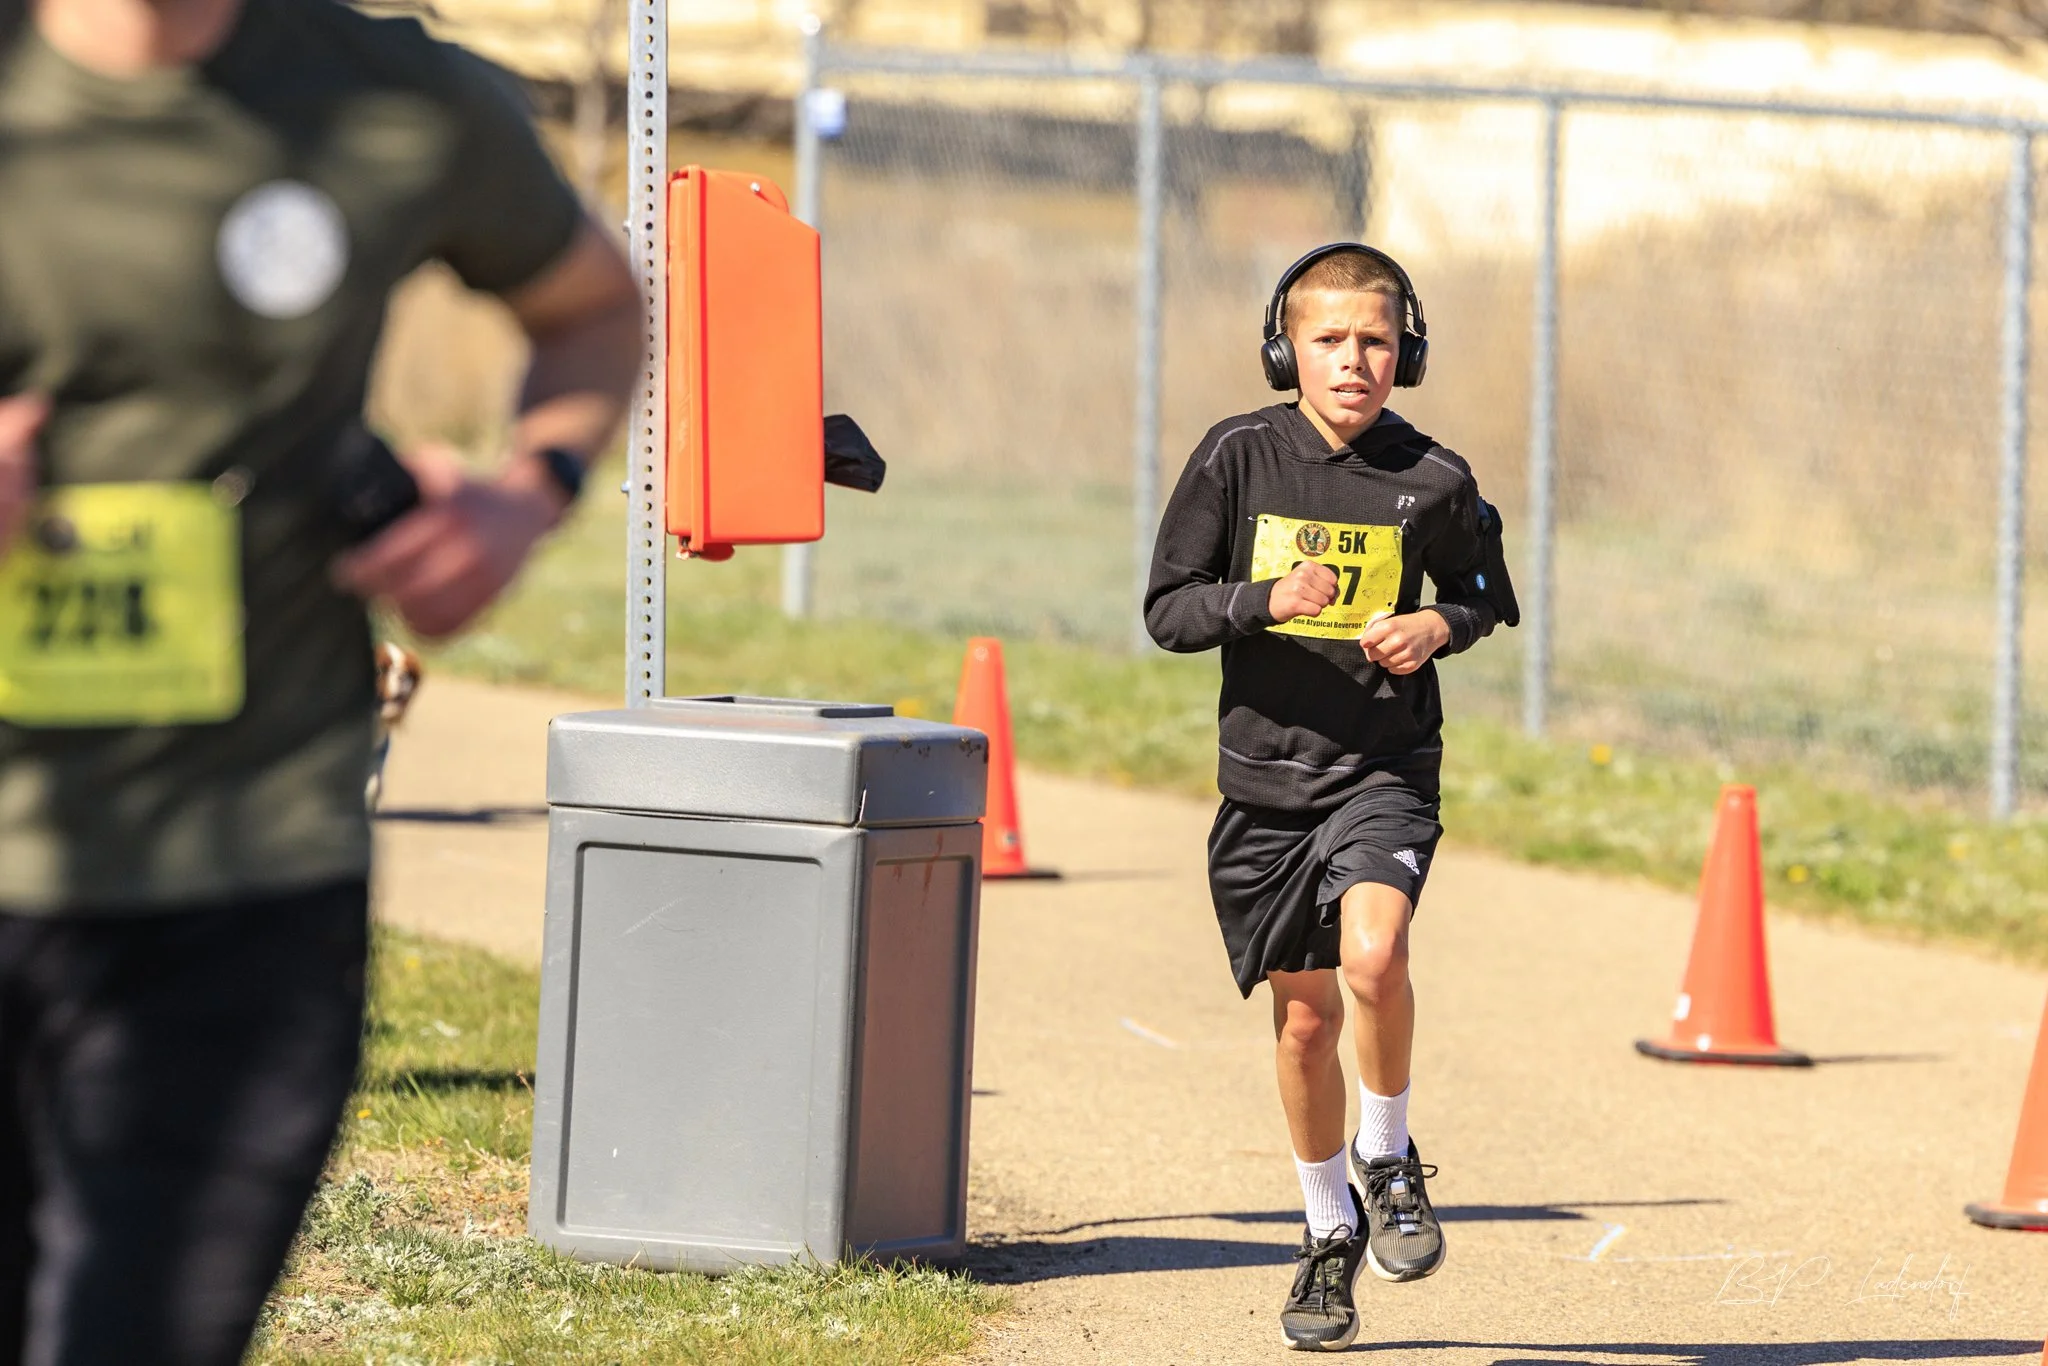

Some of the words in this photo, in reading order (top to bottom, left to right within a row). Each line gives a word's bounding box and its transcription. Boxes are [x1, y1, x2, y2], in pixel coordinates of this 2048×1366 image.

[1338, 531, 1368, 554] 5K
[1306, 618, 1332, 628] Atypical
[1334, 621, 1362, 629] Beverage
